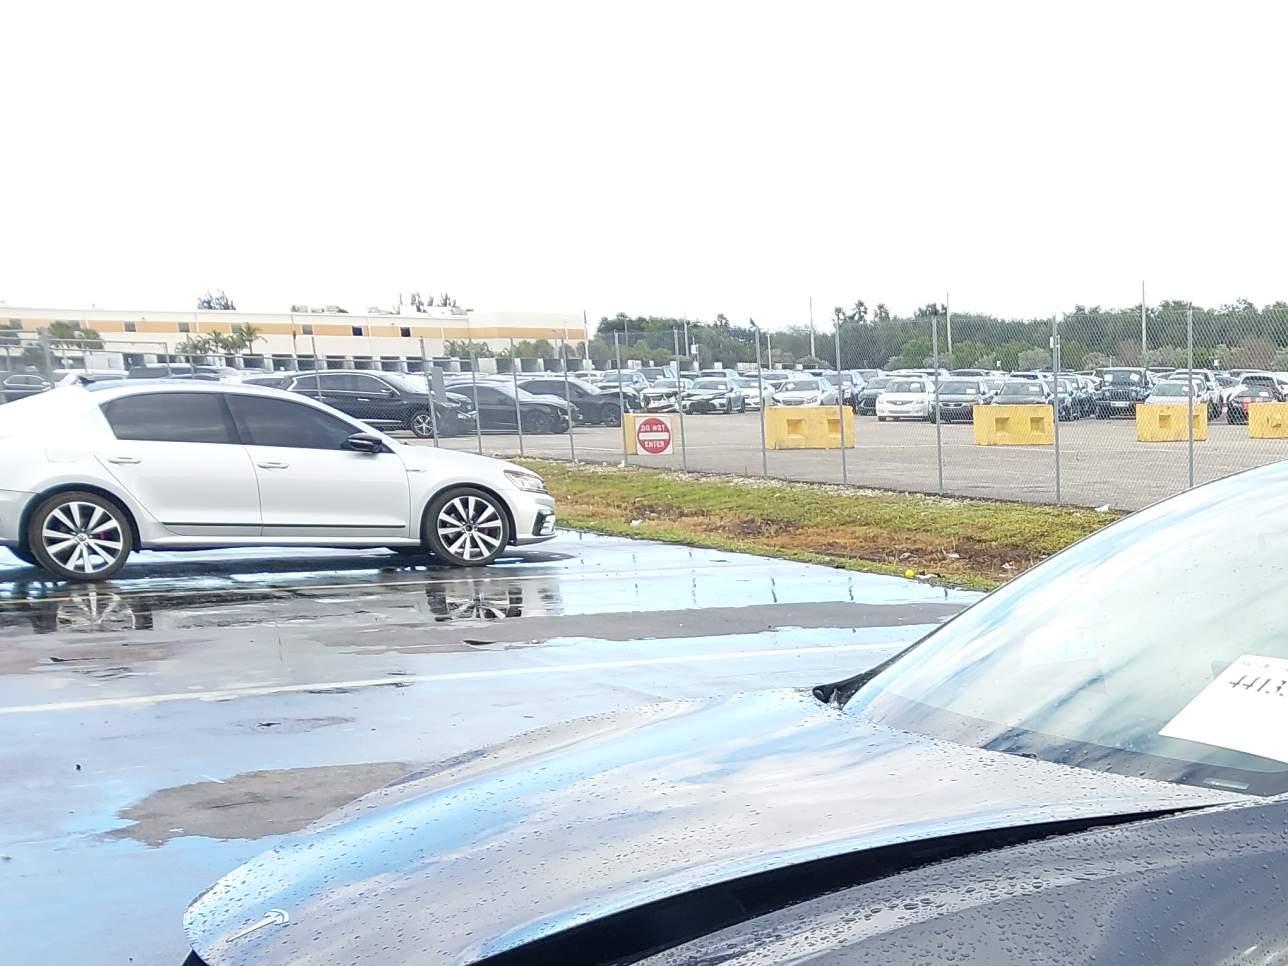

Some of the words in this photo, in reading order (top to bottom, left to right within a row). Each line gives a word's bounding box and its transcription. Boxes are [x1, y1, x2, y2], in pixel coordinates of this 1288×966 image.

[640, 424, 650, 432] DO
[652, 424, 666, 432] NOT
[644, 440, 665, 448] ENTER
